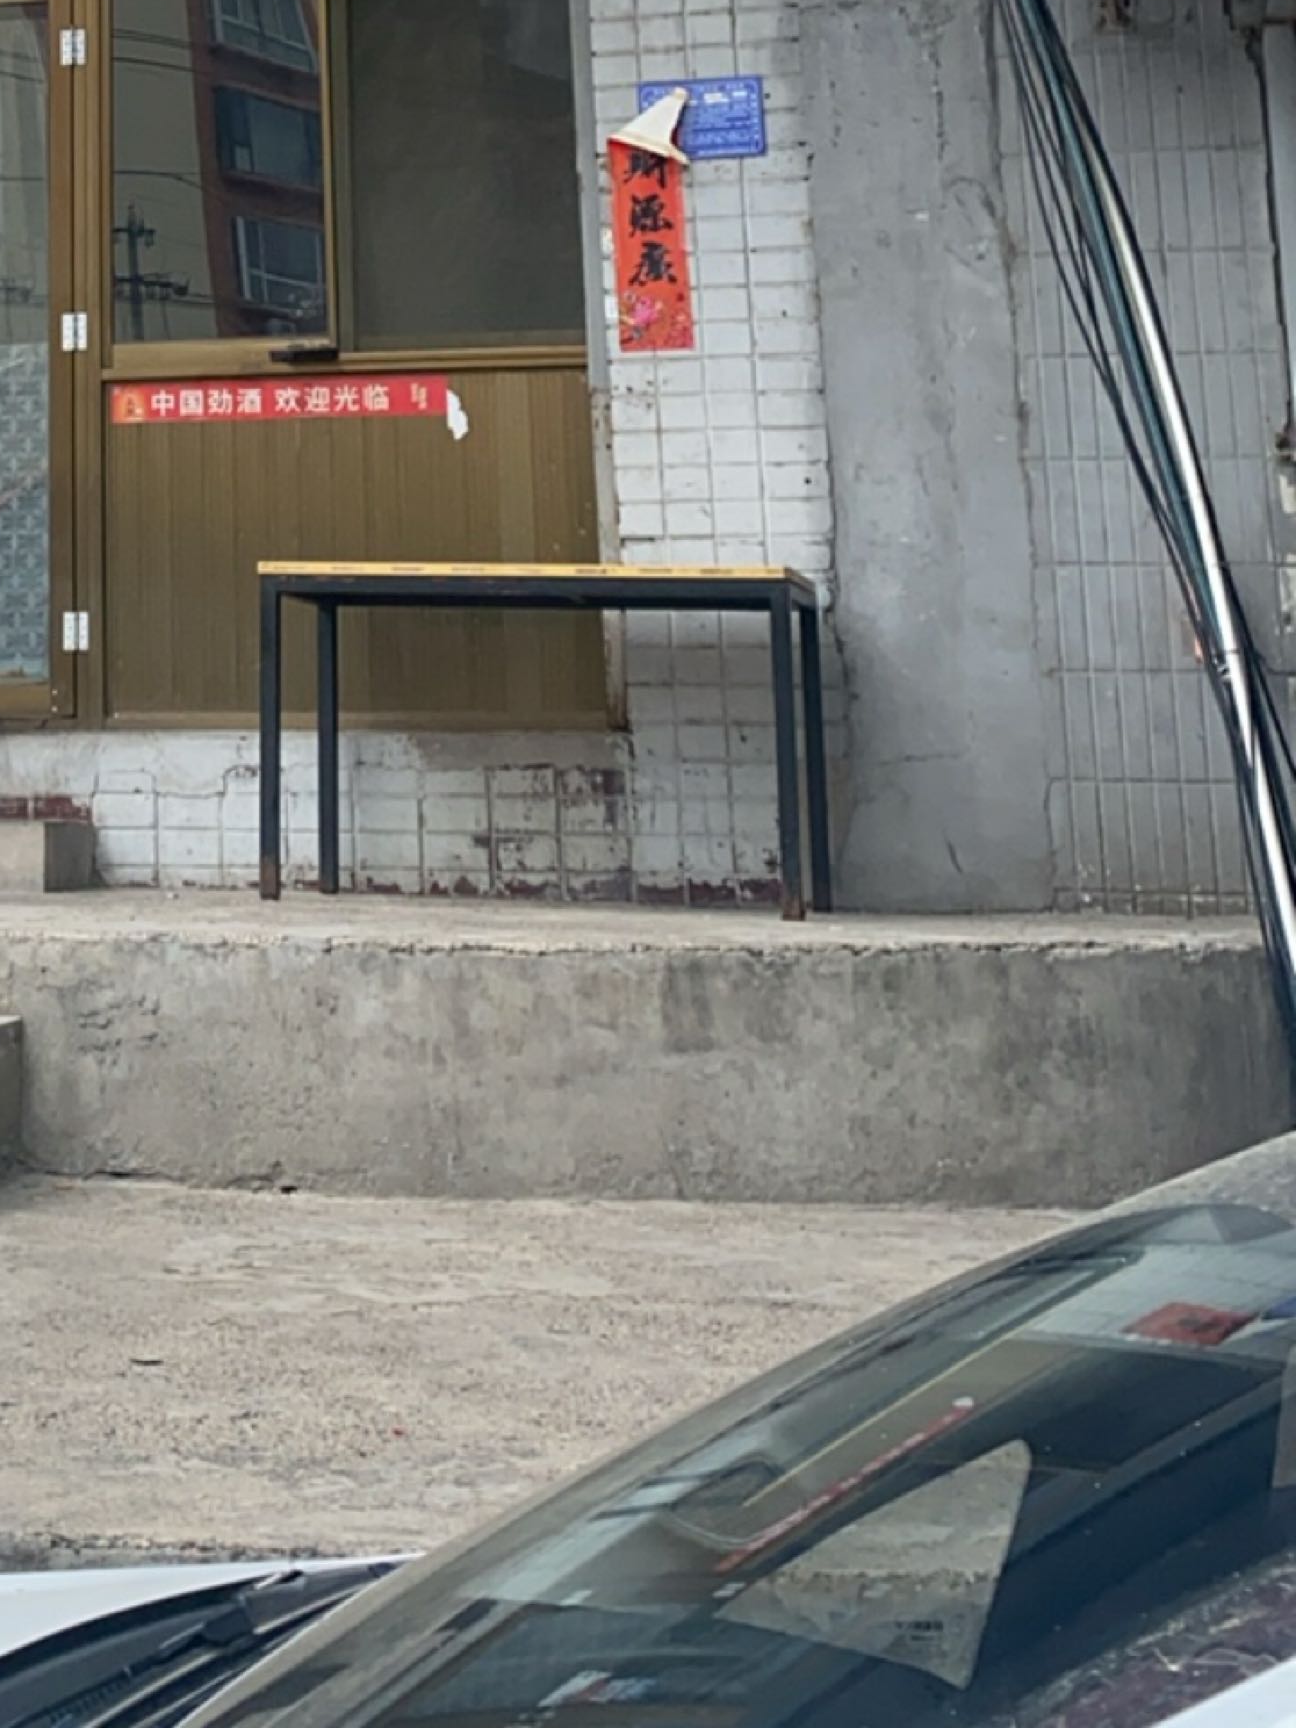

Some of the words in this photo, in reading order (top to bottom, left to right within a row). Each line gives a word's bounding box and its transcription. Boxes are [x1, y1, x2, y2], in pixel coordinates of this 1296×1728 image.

[151, 387, 262, 417] 中国劲酒
[274, 384, 390, 413] 欢迎光临
